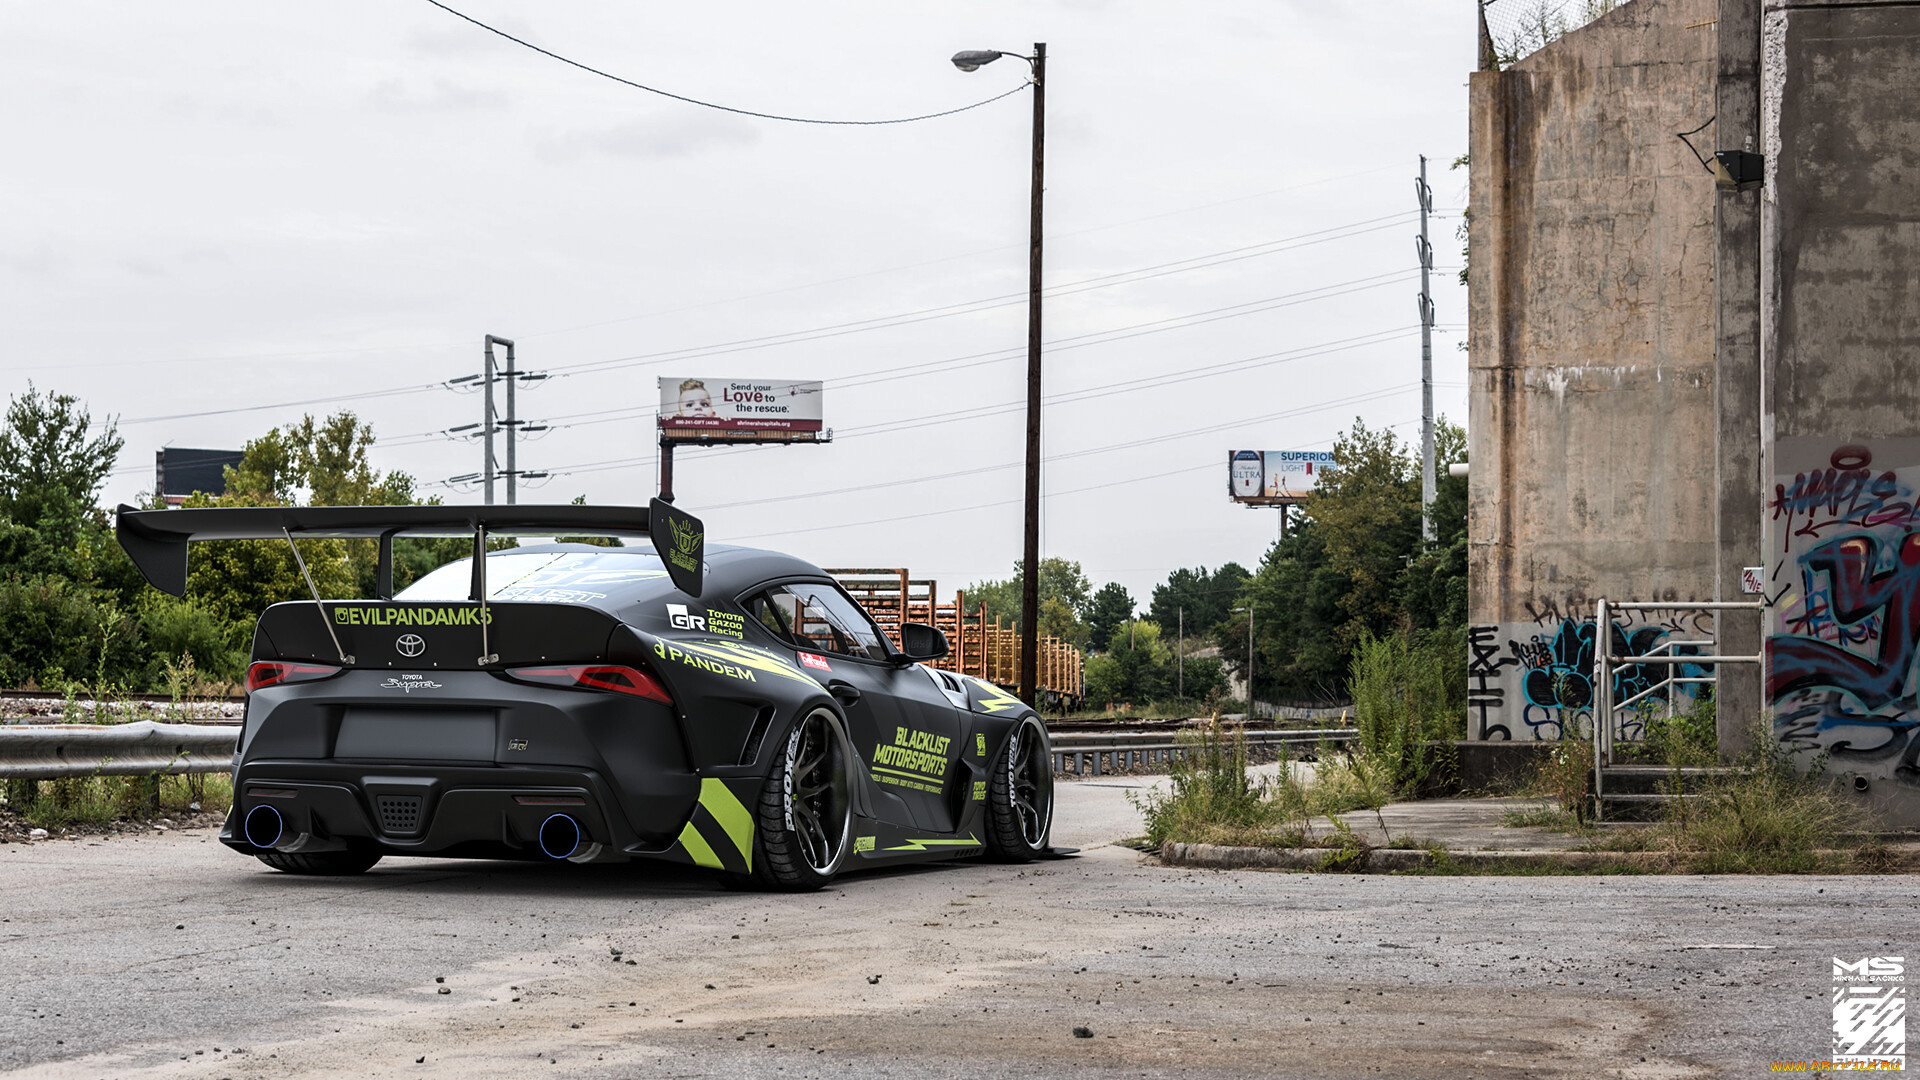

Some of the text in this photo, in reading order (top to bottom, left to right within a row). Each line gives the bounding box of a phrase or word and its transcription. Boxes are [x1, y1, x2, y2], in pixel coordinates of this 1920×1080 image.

[723, 388, 776, 402] Love to
[730, 383, 772, 394] Send your
[735, 403, 753, 412] the
[1281, 452, 1336, 461] SUPERIOR
[1233, 471, 1261, 479] ULTRA
[1281, 464, 1305, 472] LIGHT
[349, 607, 493, 626] EVILPANDAMK5
[669, 609, 707, 632] GR
[707, 609, 745, 623] TOYOTA
[707, 617, 743, 630] GAZOO
[709, 626, 744, 640] Racing
[669, 646, 757, 683] PANDEM
[380, 678, 443, 693] Supra
[895, 726, 951, 756] BLACKLIST
[872, 744, 948, 776] MOTORSPORTS
[1008, 734, 1017, 808] TOYO TIRES
[783, 726, 800, 831] PROXES
